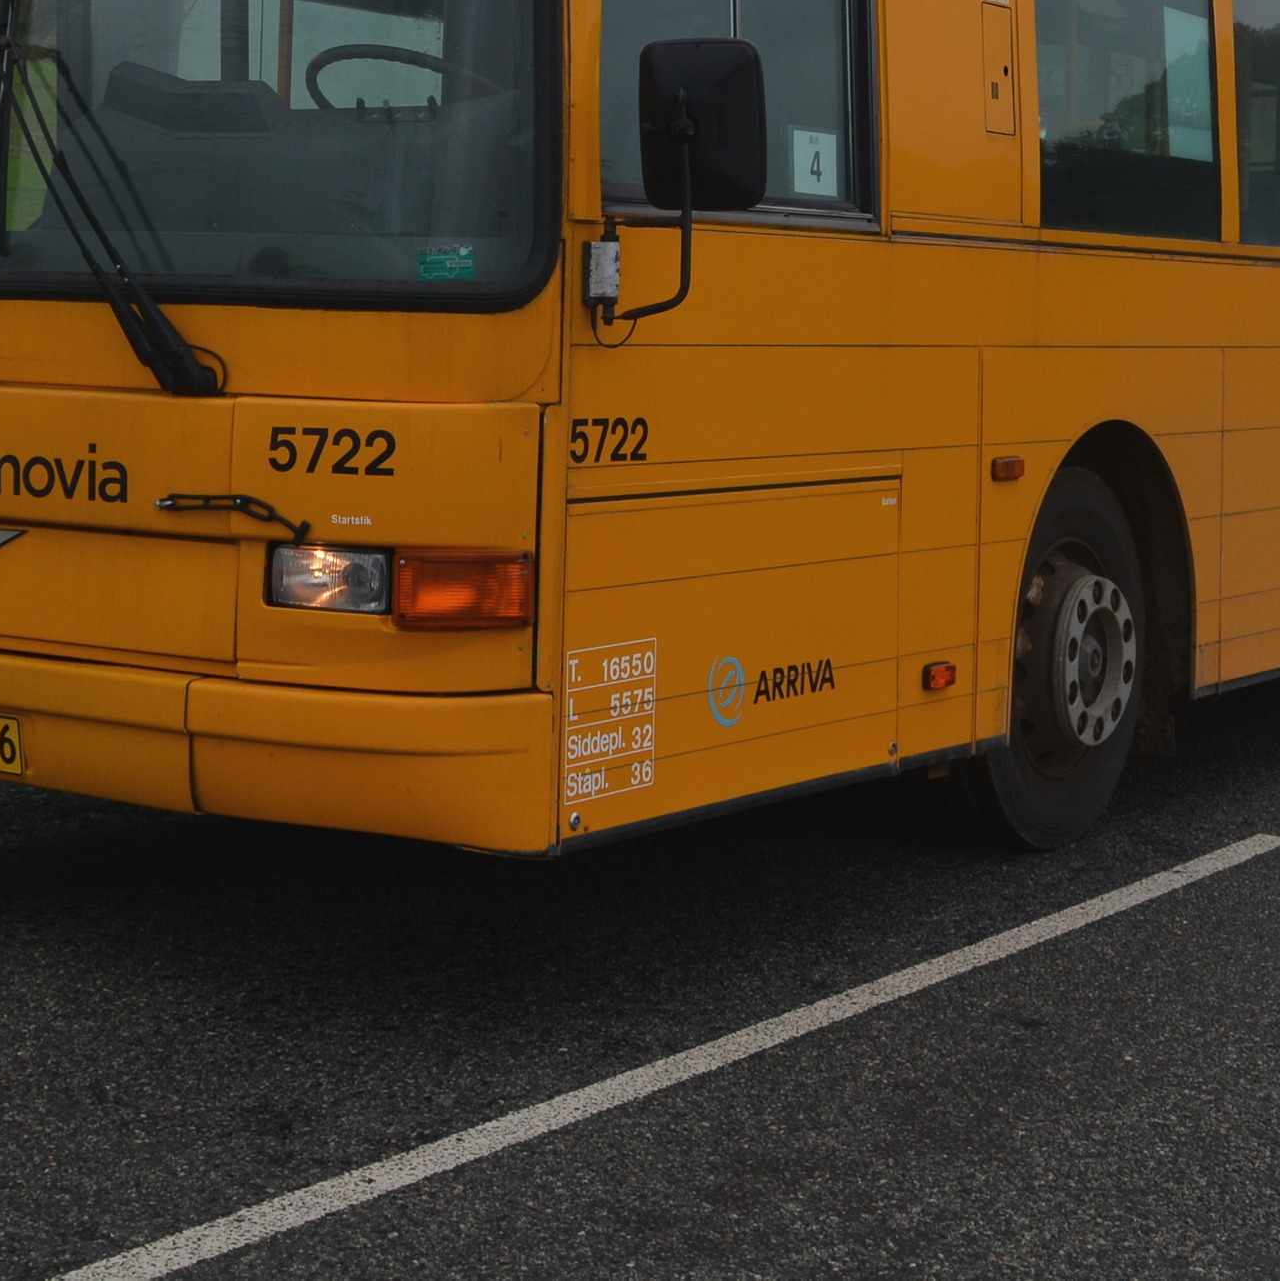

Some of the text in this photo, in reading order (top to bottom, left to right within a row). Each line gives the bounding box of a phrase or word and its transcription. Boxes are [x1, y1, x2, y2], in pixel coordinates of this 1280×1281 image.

[810, 150, 823, 183] 4
[267, 426, 397, 477] 5722
[569, 417, 649, 464] 5722
[331, 513, 373, 526] Startstik
[602, 650, 655, 682] 16550
[752, 657, 836, 705] ARRIVA
[568, 686, 654, 722] L 5575
[567, 723, 653, 760] Siddepl. 32
[566, 759, 653, 798] Ståpl. 36
